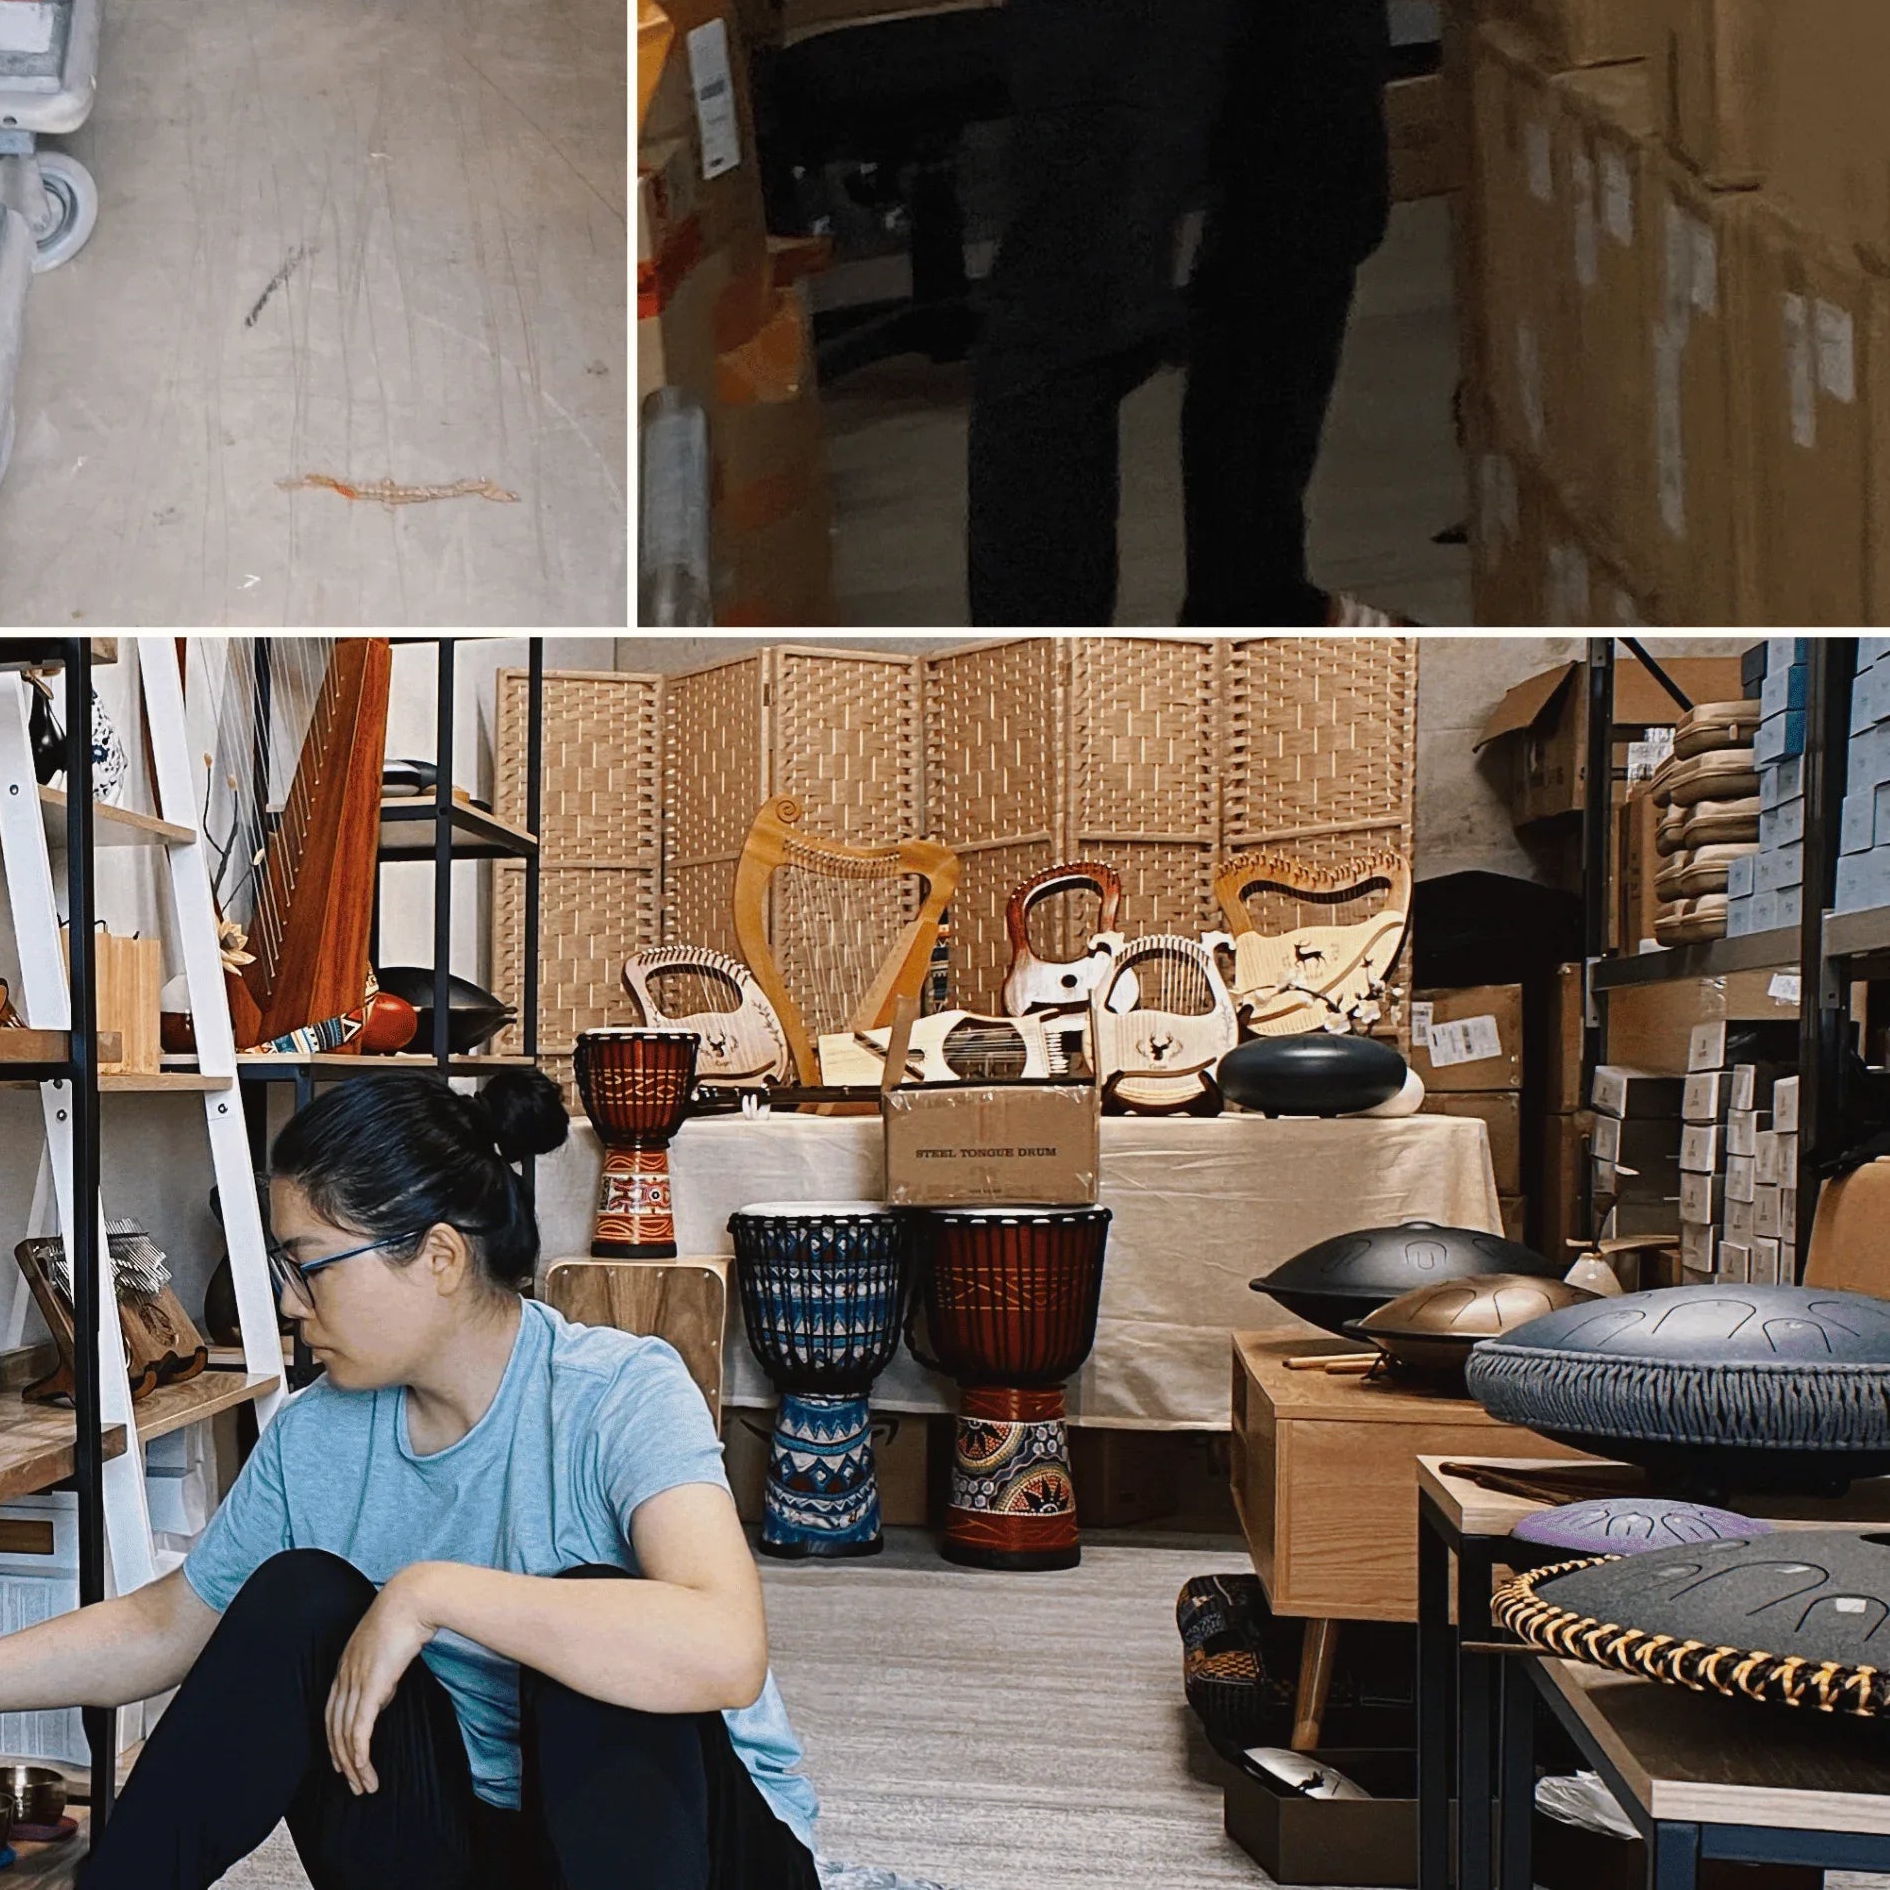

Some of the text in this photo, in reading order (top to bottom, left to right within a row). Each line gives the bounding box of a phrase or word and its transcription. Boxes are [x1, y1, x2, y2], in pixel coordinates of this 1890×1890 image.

[916, 1147, 1056, 1159] STEEL TONGUE DRUM
